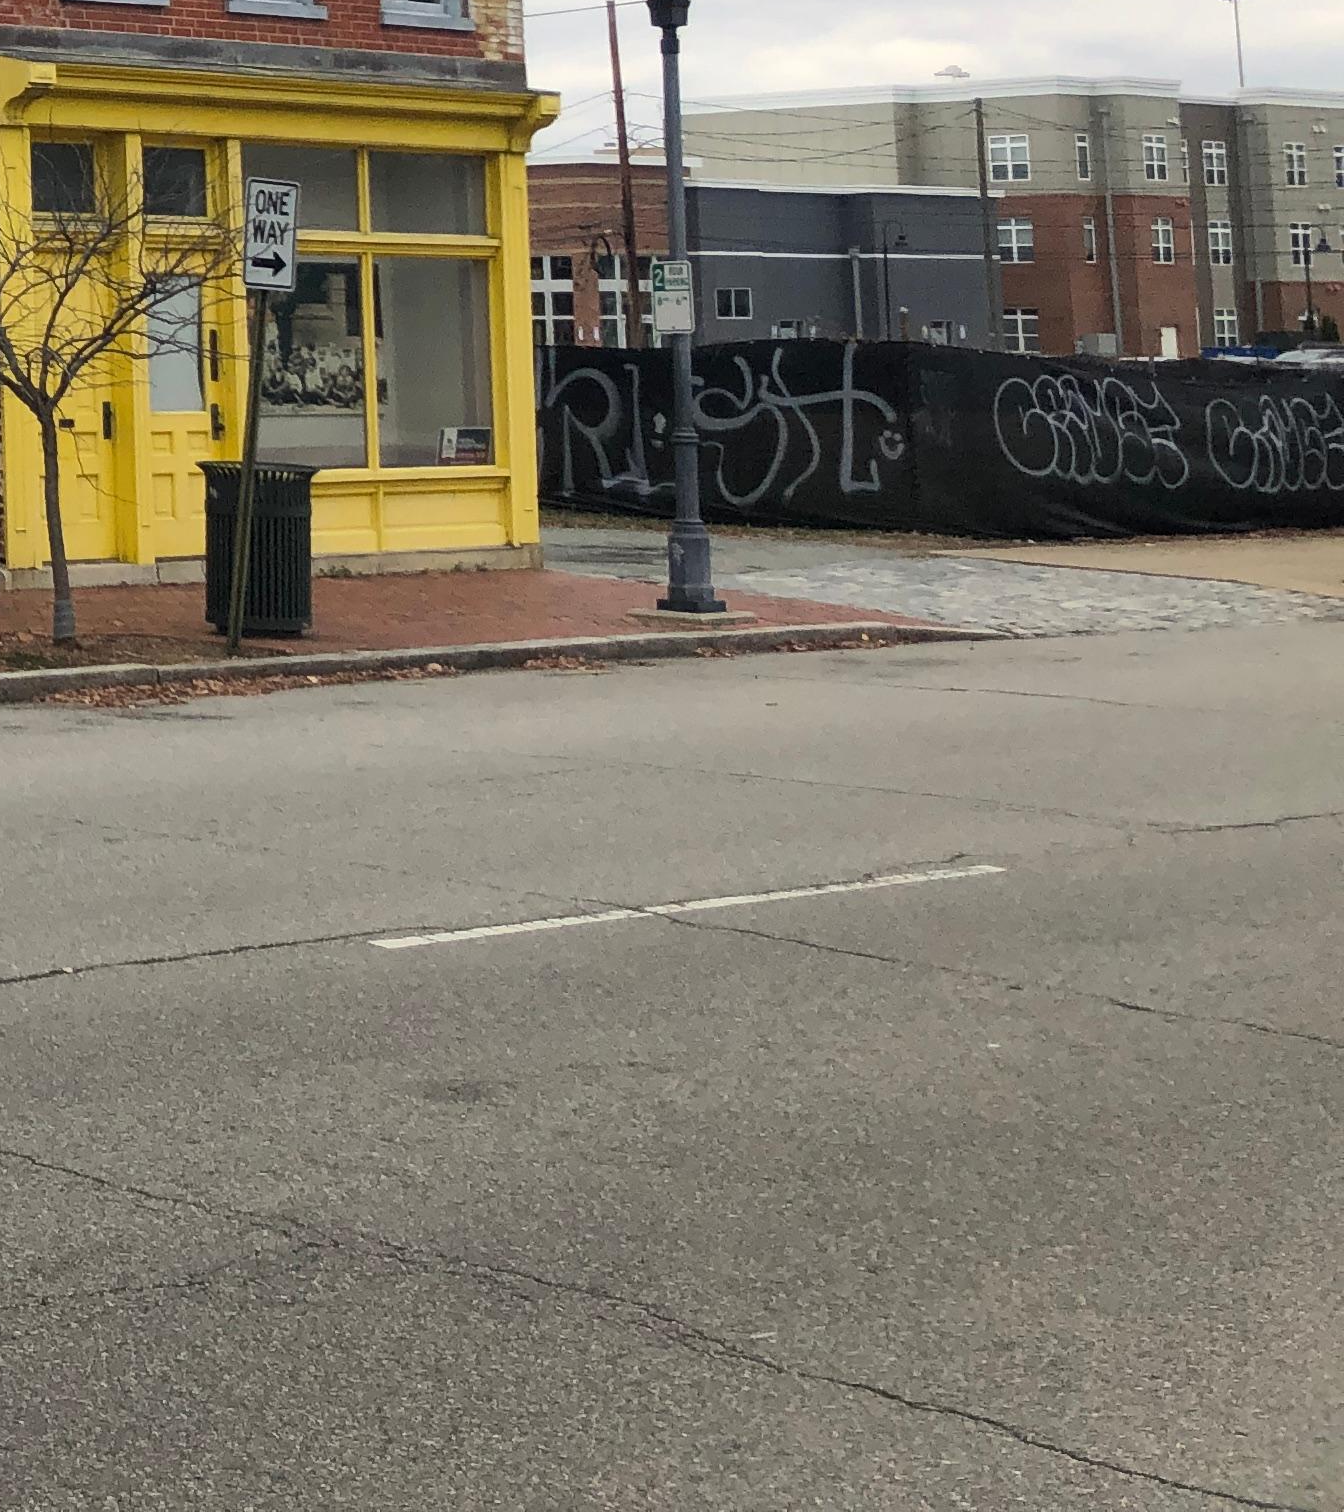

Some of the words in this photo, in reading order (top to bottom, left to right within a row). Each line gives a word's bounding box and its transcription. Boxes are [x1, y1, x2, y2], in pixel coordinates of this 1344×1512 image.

[255, 189, 290, 216] ONE
[252, 218, 289, 245] WAY
[653, 268, 664, 287] 2
